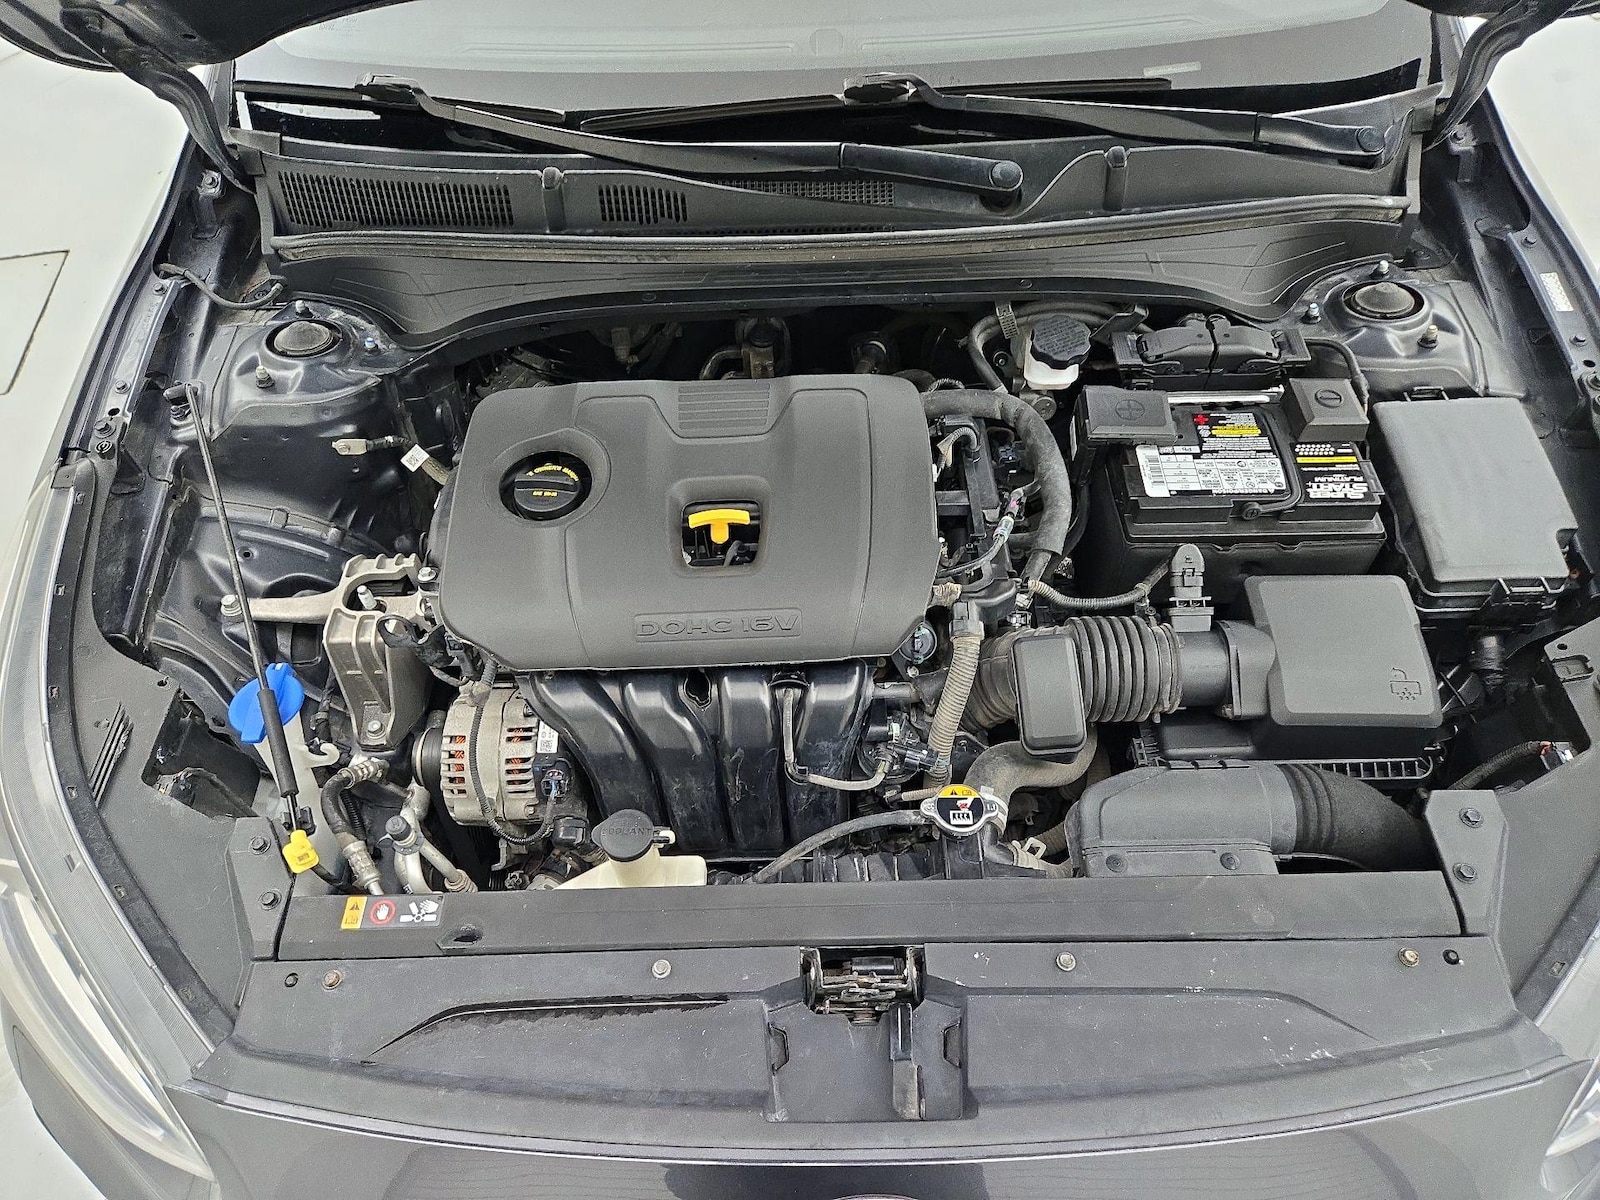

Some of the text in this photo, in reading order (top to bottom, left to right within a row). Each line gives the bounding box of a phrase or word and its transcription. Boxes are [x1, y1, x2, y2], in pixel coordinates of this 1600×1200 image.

[1309, 491, 1364, 499] SUPER
[637, 614, 799, 637] DOHC 16V
